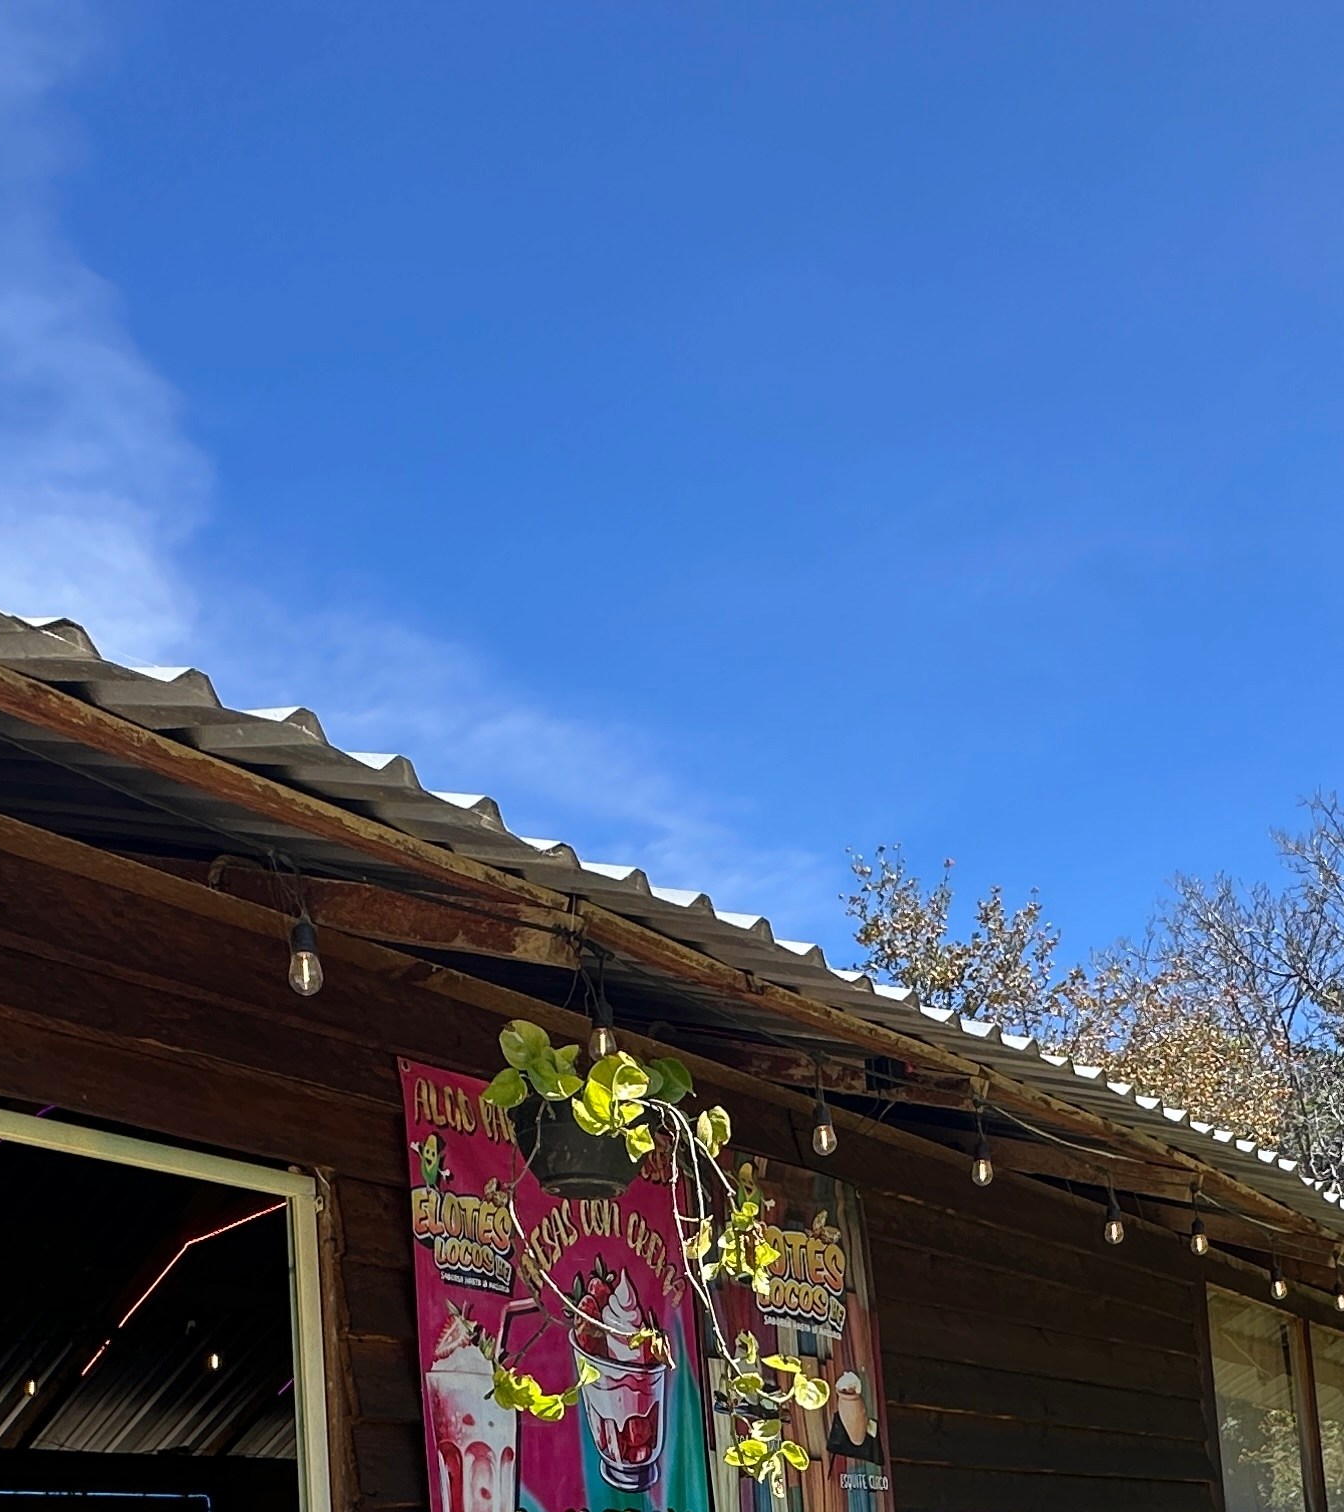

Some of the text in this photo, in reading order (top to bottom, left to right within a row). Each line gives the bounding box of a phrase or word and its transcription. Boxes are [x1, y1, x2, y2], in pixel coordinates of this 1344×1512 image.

[414, 1077, 476, 1133] ALGO
[412, 1189, 513, 1253] ELOTES
[579, 1199, 620, 1238] CON
[626, 1211, 686, 1307] CREMA
[435, 1239, 494, 1275] LOCOS
[764, 1226, 846, 1292] OTES
